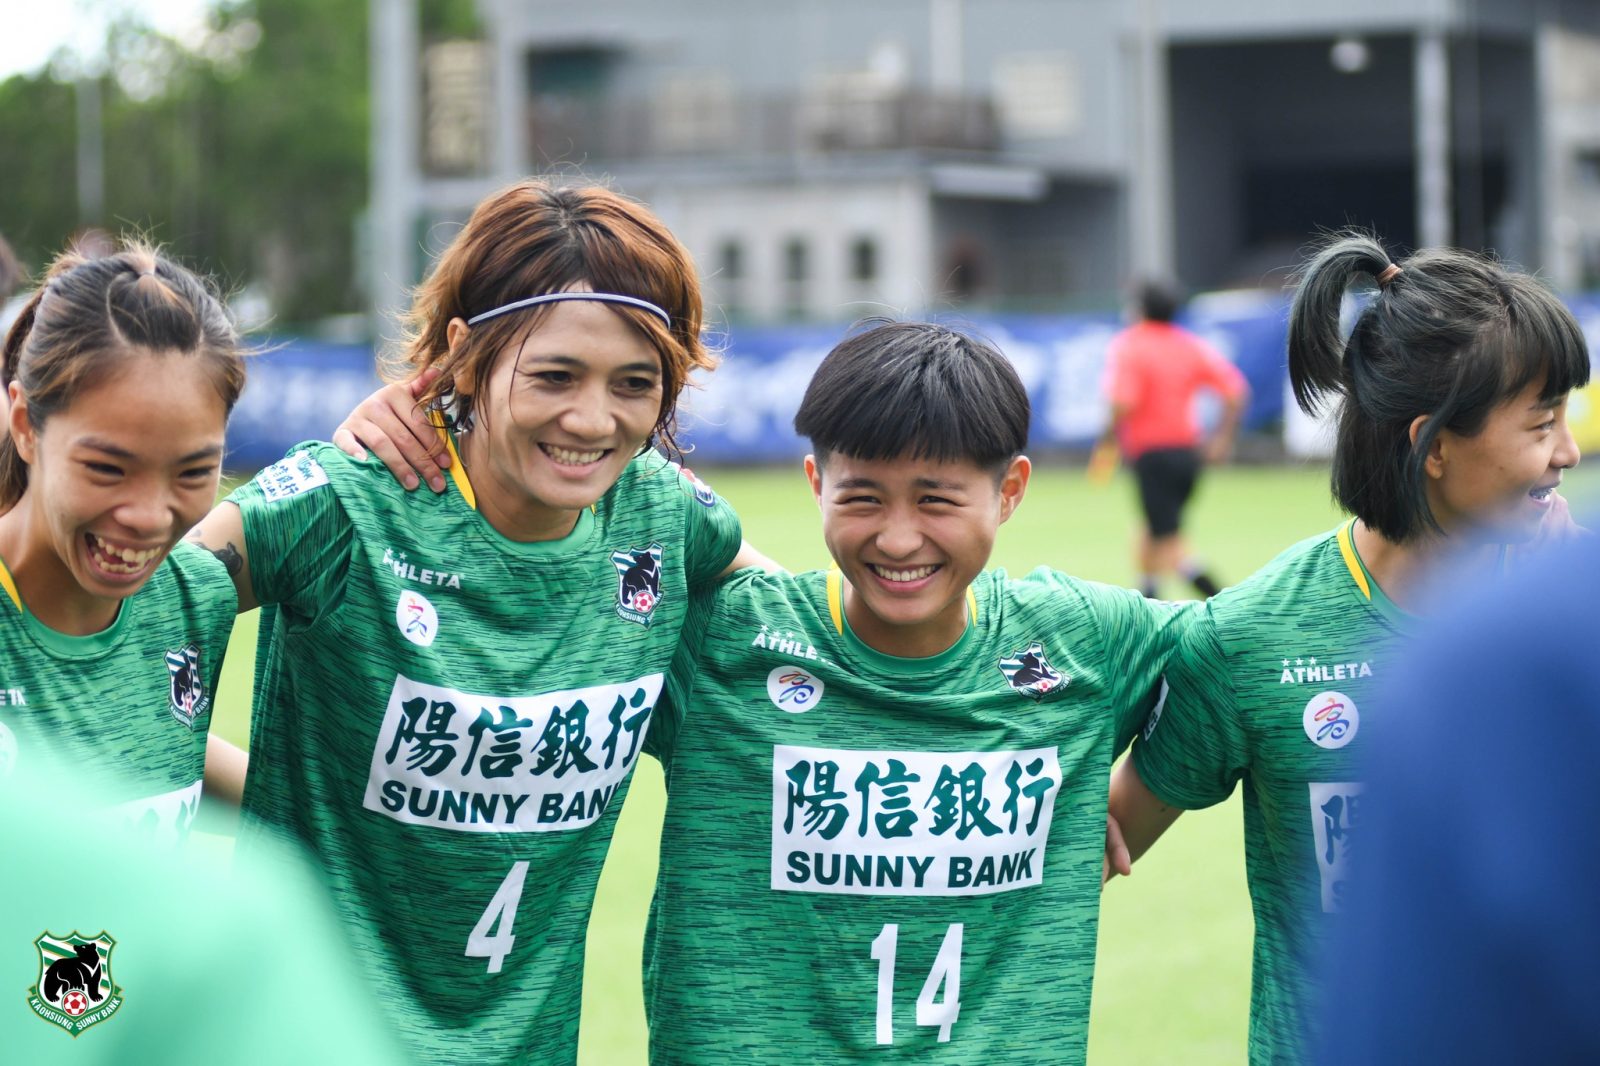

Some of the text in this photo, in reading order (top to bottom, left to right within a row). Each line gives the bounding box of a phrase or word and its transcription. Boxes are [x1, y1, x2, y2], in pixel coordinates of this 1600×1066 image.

[751, 632, 833, 666] ATHLE
[1281, 662, 1372, 684] ATHLETA
[385, 687, 653, 779] 陽信銀行
[379, 780, 620, 824] SUNNY BAN
[784, 757, 1055, 841] 陽信銀行
[786, 848, 1037, 889] SUNNY BANK
[464, 861, 530, 974] 4
[870, 923, 964, 1045] 14
